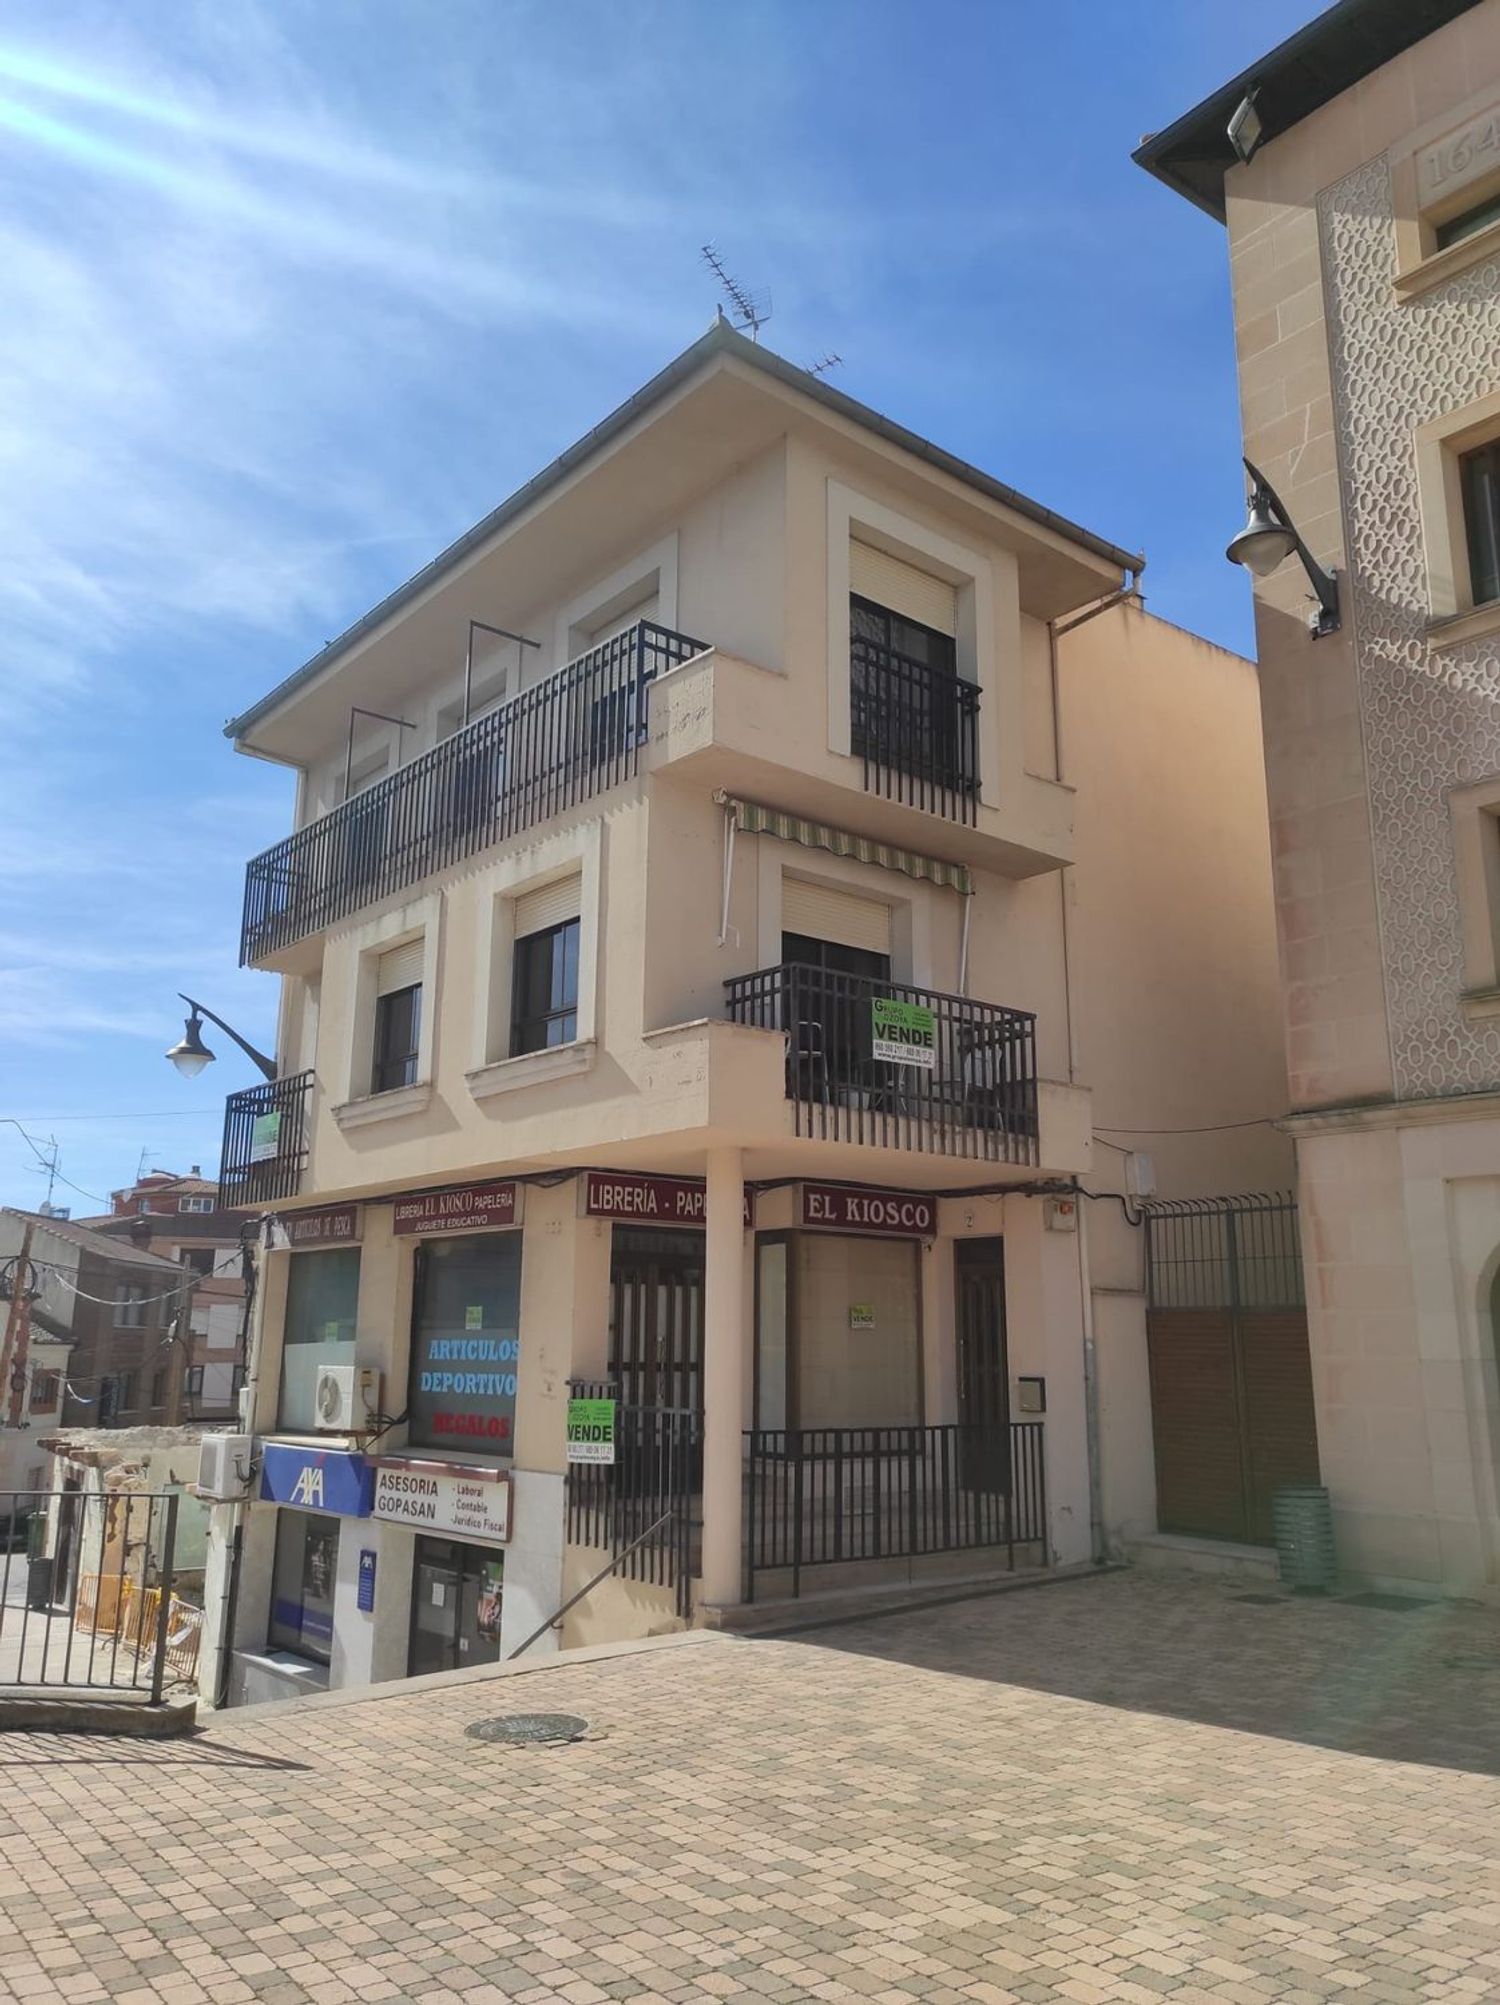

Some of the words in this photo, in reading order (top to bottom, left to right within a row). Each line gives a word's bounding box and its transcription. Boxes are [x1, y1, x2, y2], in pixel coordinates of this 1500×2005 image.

[875, 1022, 933, 1048] VENDE
[425, 1197, 437, 1216] EL
[439, 1191, 474, 1214] KIOSCO
[589, 1182, 658, 1214] LIBRERÍA
[414, 1217, 446, 1232] JUGUETE
[446, 1214, 489, 1229] EDUCATIVO
[808, 1194, 837, 1219] EL
[846, 1197, 930, 1228] KIOSCO
[428, 1339, 521, 1361] ARTICULOS
[432, 1412, 510, 1440] REGALOS
[567, 1424, 612, 1442] VENDE
[290, 1467, 324, 1507] AXA
[380, 1473, 438, 1498] ASESORIA
[457, 1484, 484, 1498] Laboral
[378, 1495, 436, 1520] GOPASAN
[456, 1499, 488, 1514] Contable
[483, 1518, 505, 1533] Fiscal
